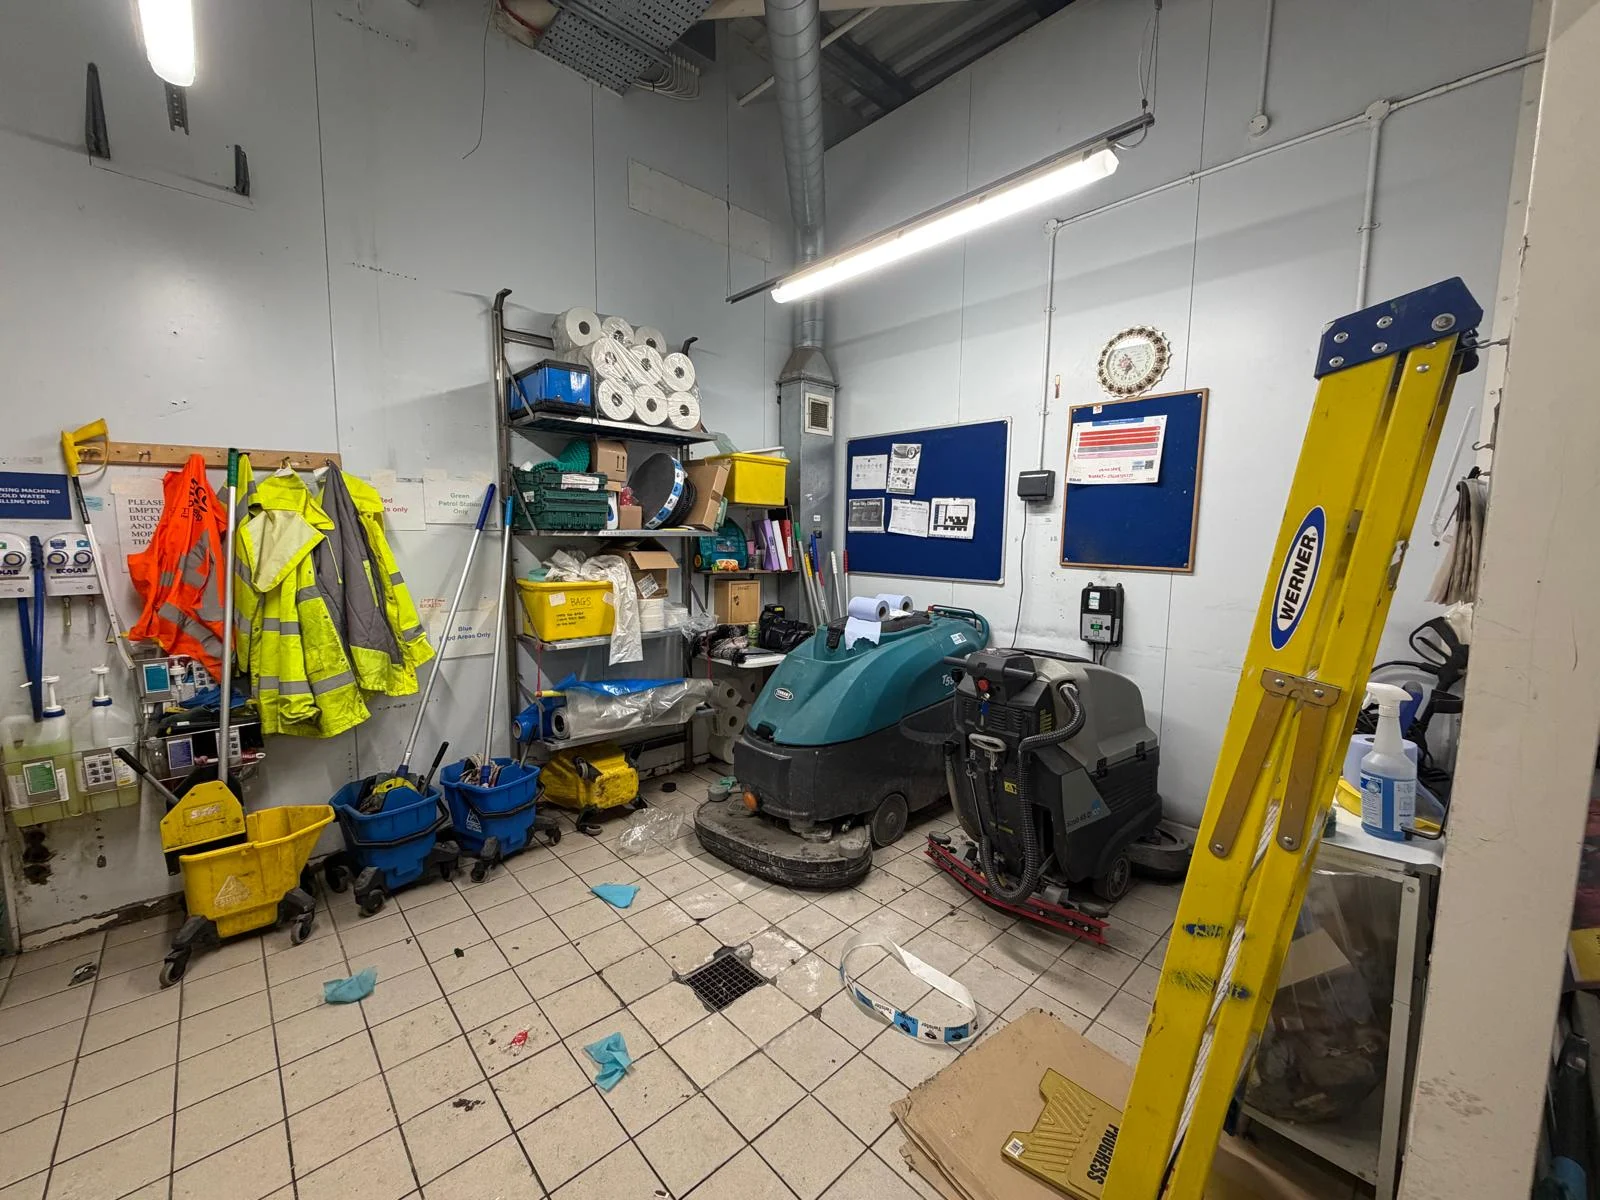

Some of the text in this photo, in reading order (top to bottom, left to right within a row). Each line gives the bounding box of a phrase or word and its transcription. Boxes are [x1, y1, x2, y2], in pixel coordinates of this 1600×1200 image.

[1279, 534, 1317, 621] WERNER
[570, 596, 592, 607] BAGS
[476, 631, 491, 639] Only
[921, 1021, 942, 1032] Twister
[1086, 1123, 1120, 1185] PROGRESS
